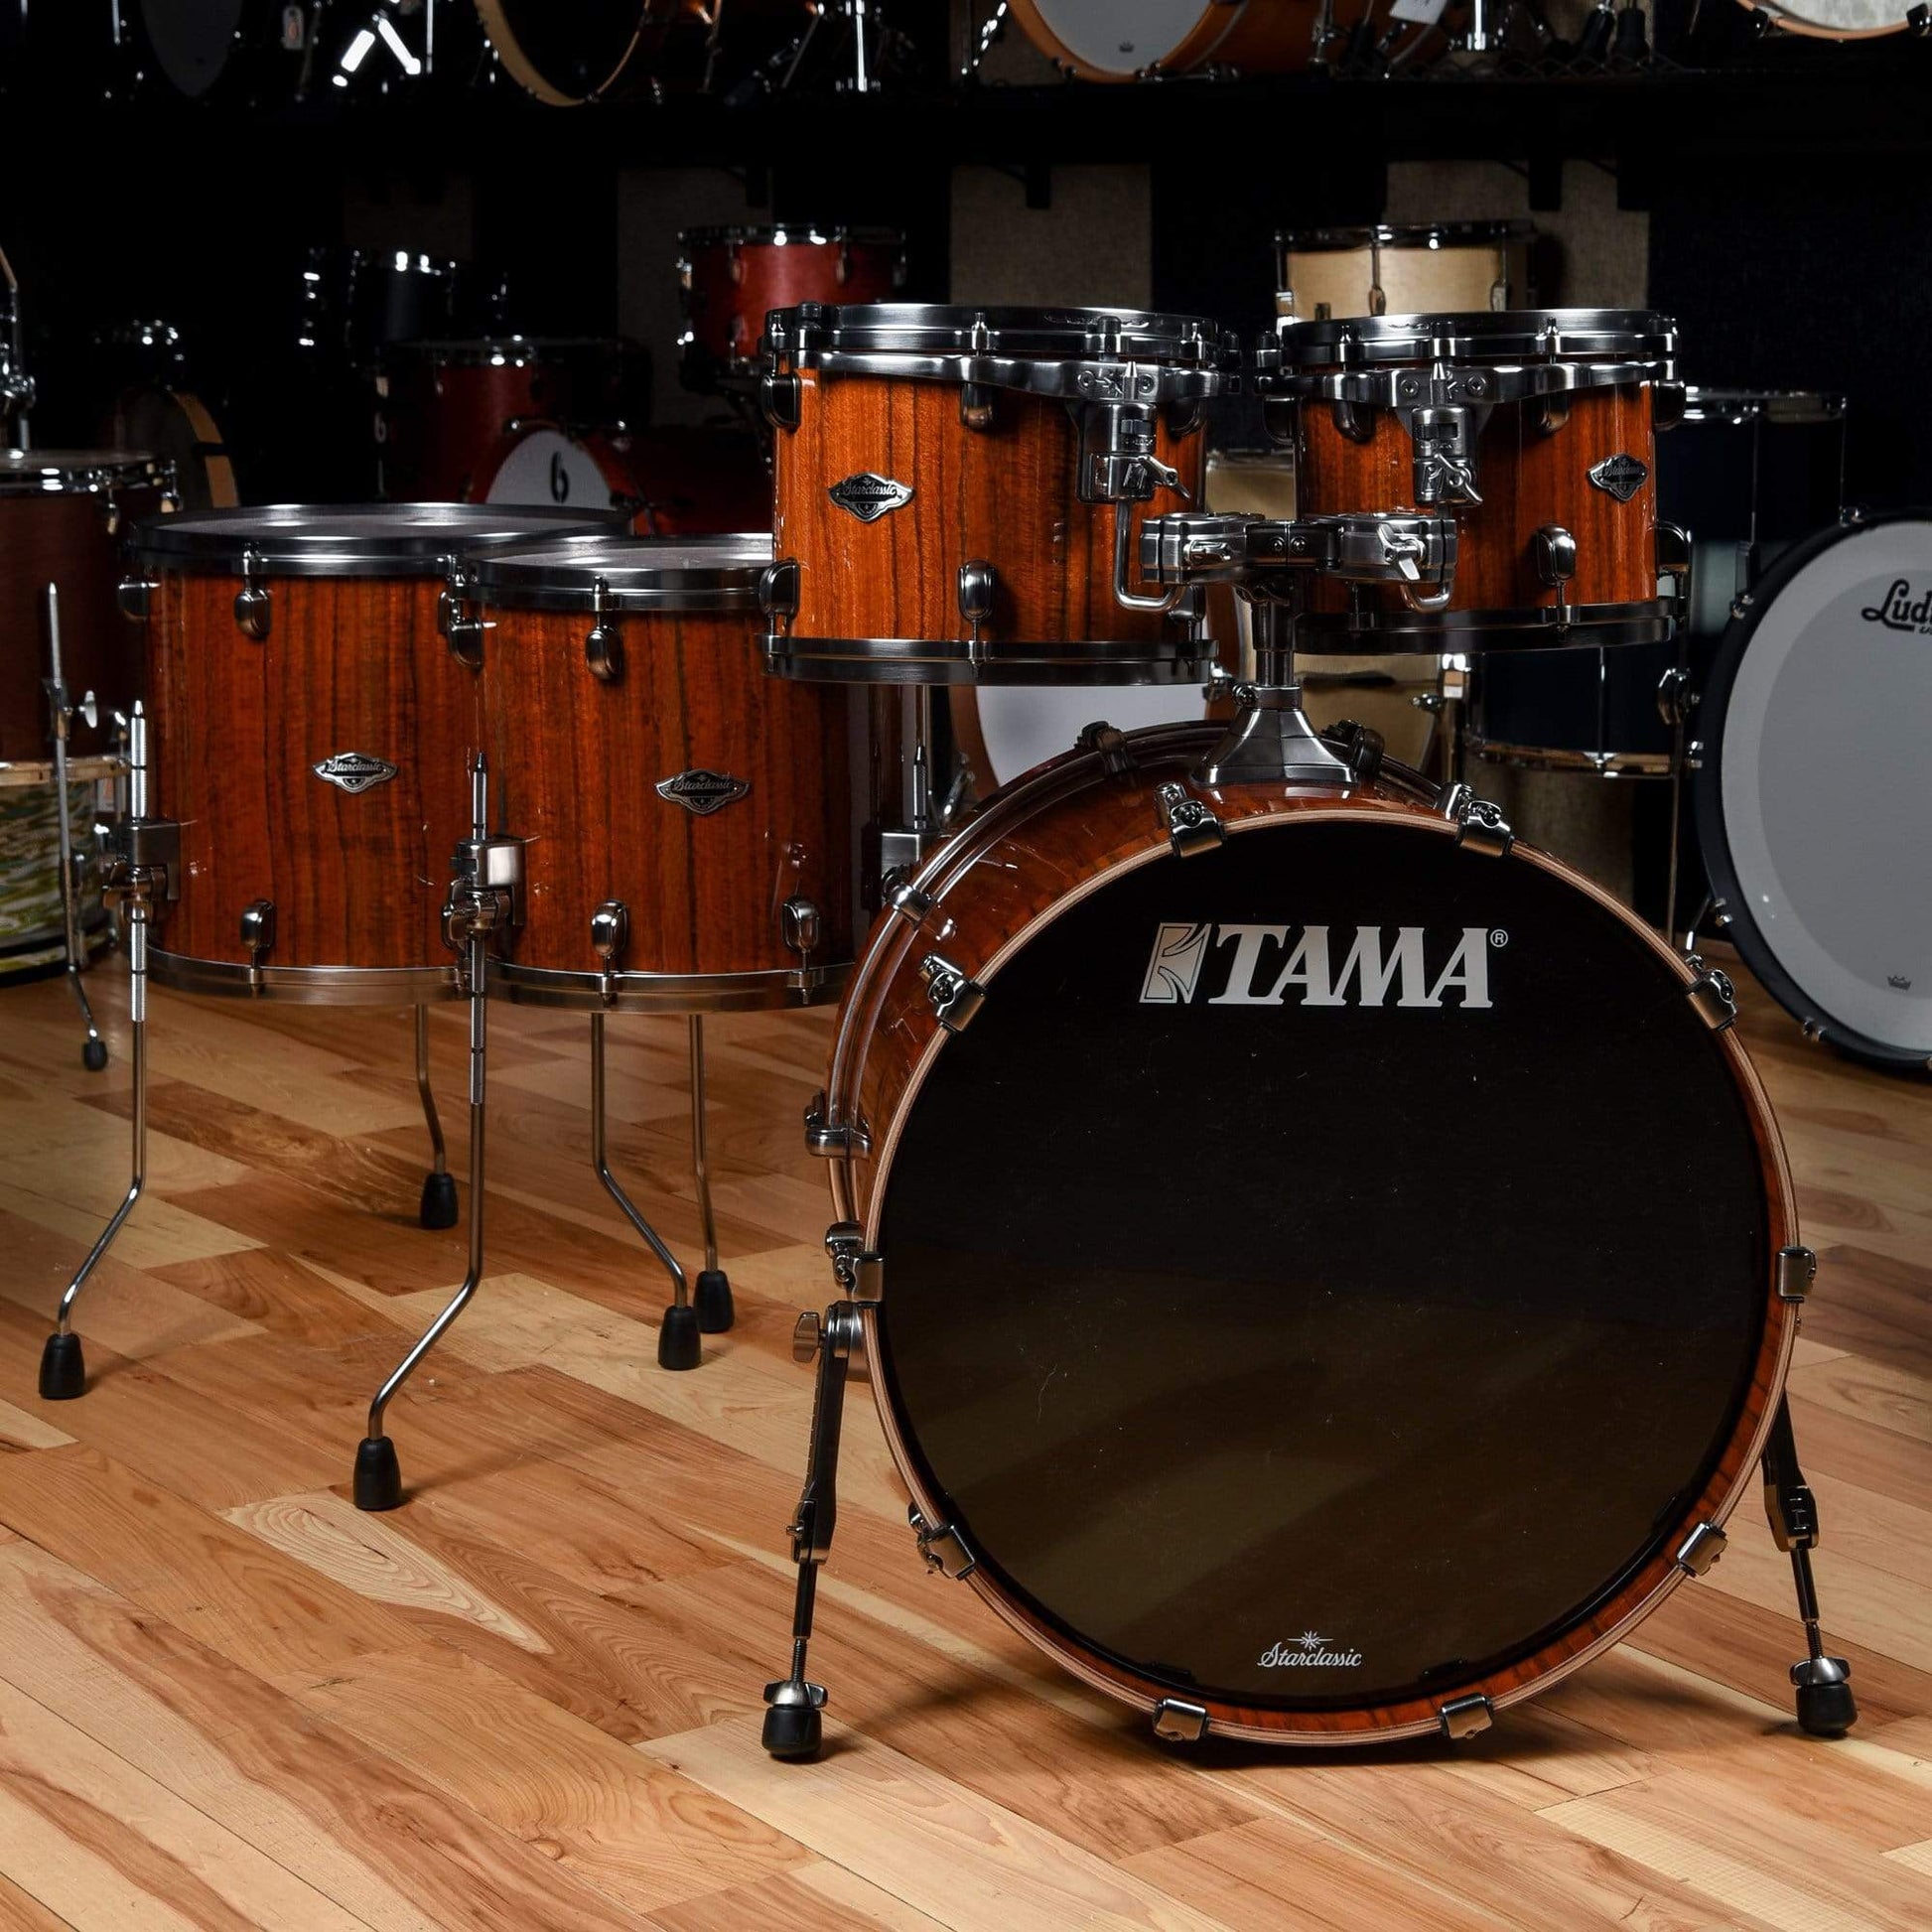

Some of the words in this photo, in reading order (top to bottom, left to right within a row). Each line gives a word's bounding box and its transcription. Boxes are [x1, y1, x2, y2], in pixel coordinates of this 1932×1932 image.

[551, 451, 570, 503] 6
[842, 481, 897, 495] Starclassic
[1257, 1641, 1362, 1668] Starclassic
